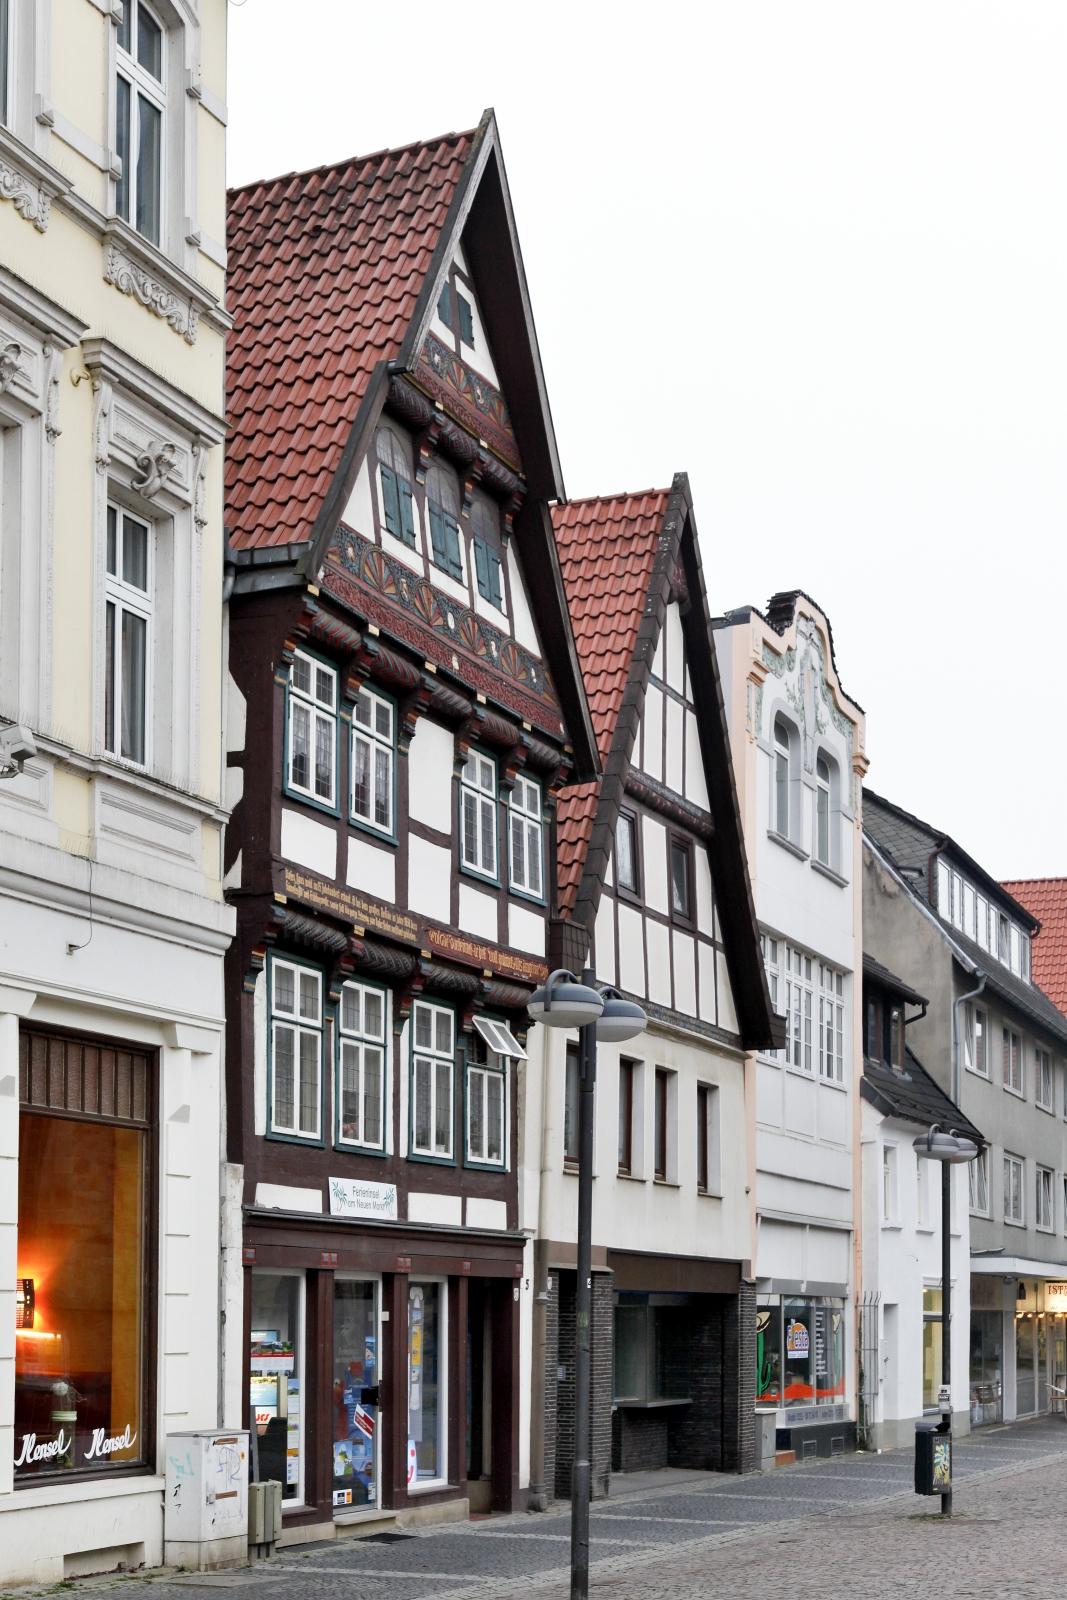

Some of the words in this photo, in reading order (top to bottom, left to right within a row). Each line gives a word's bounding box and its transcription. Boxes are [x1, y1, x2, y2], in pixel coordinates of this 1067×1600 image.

[352, 1186, 380, 1199] Ferieninsel
[356, 1199, 372, 1210] Neuen
[14, 1428, 72, 1467] Hensel
[84, 1423, 137, 1460] Hensel
